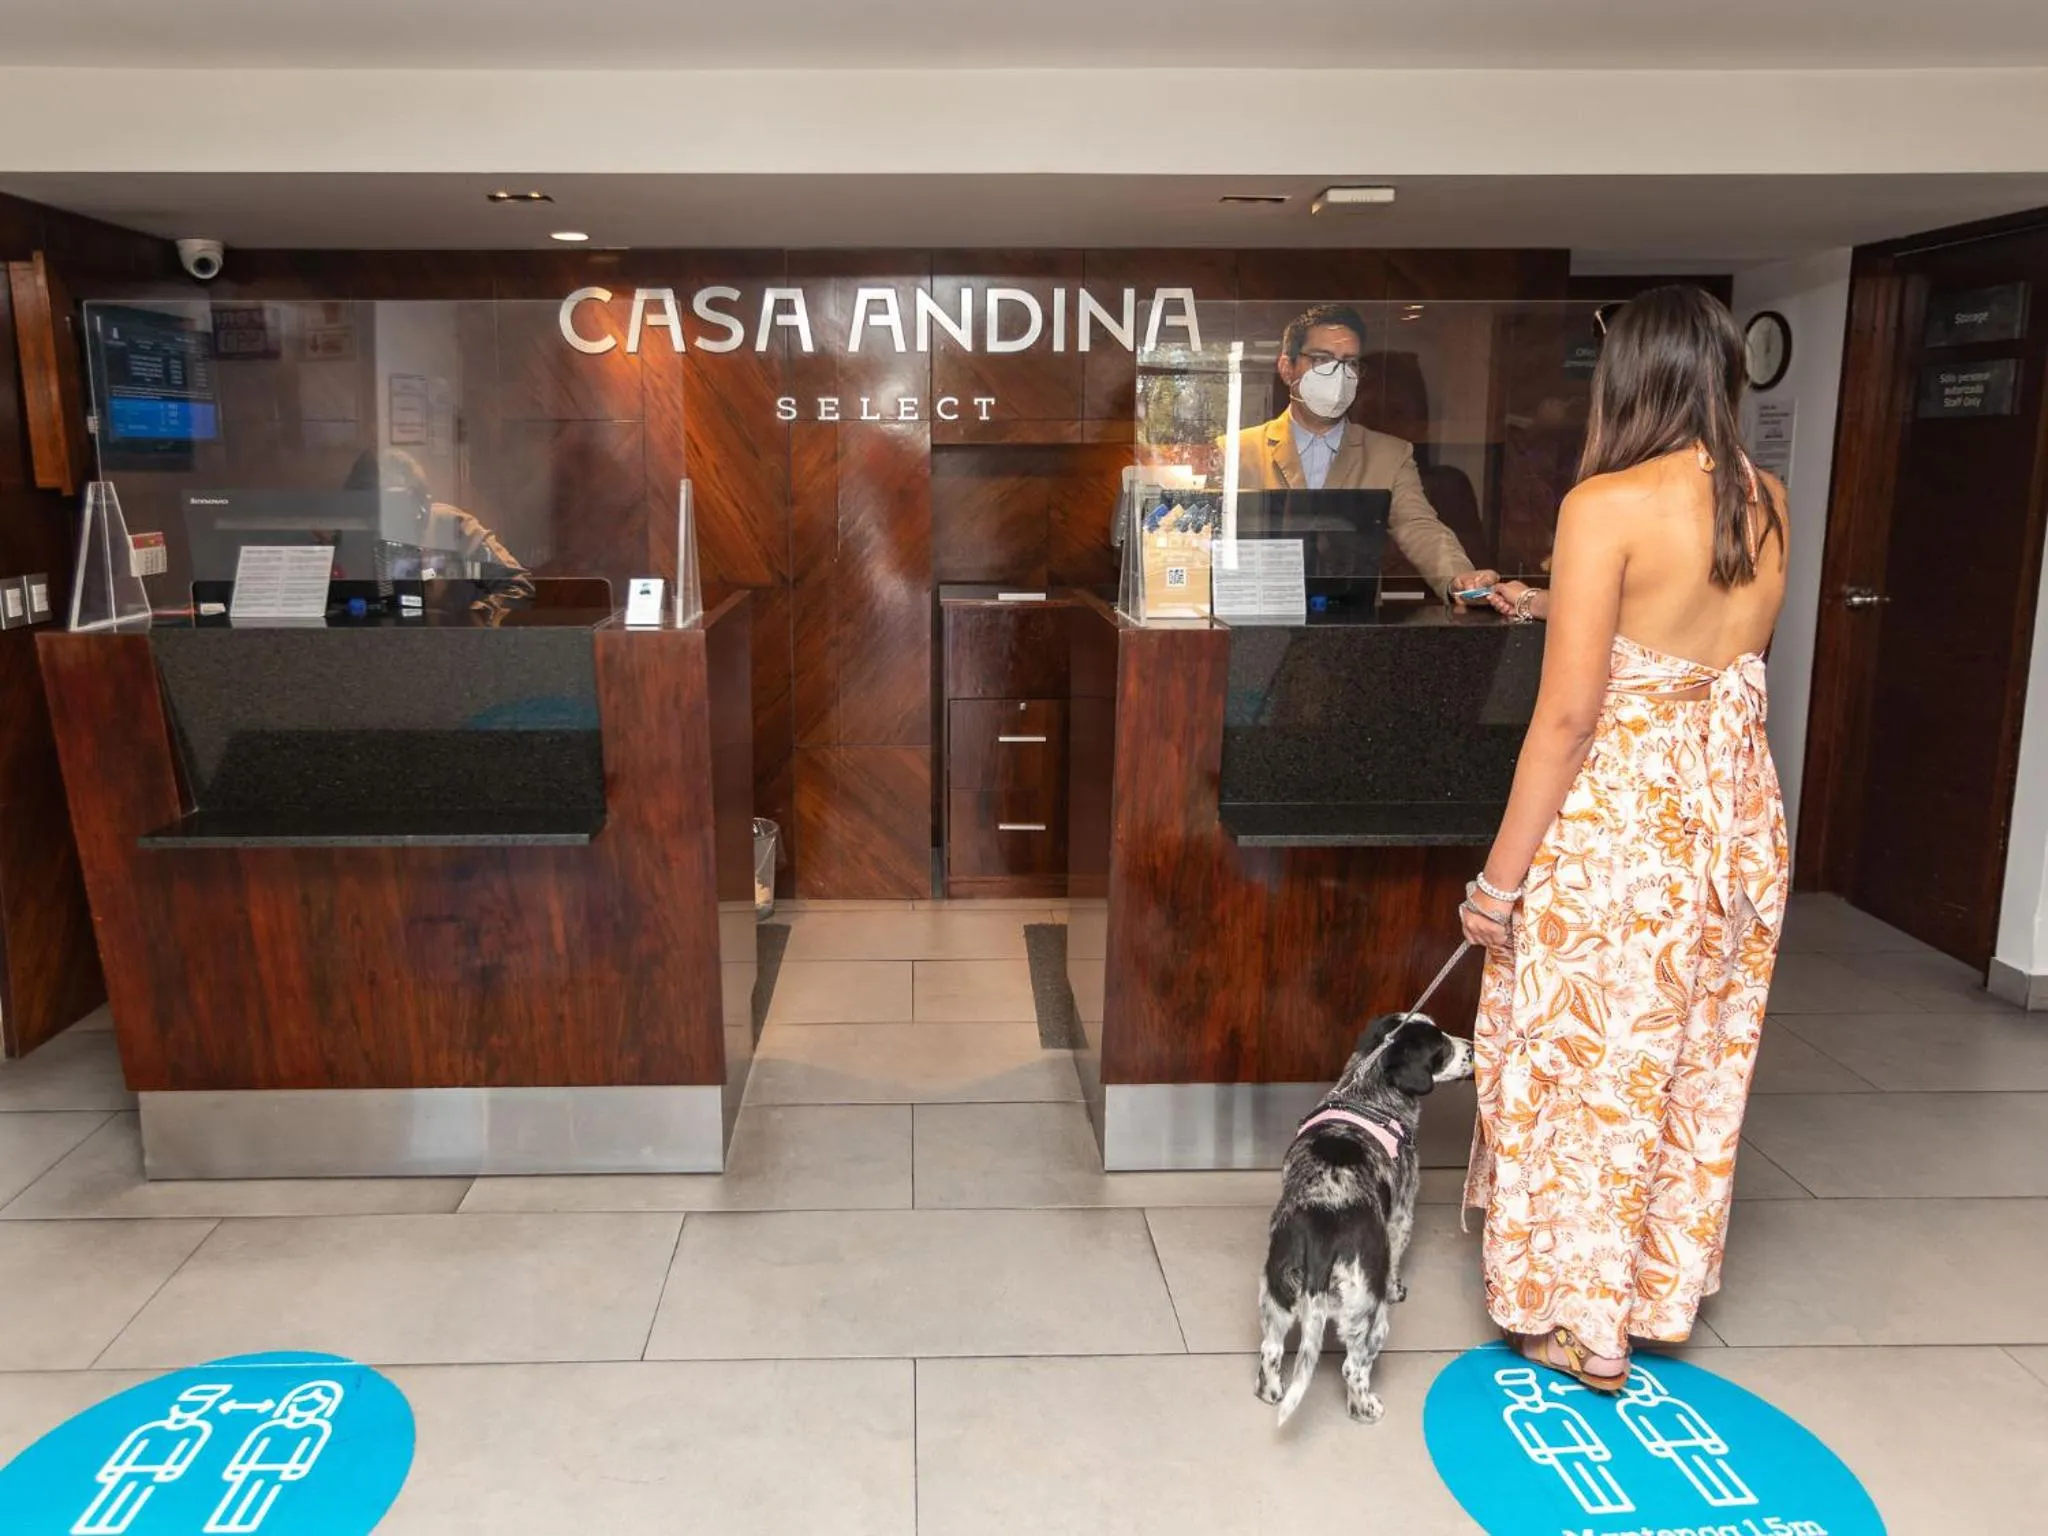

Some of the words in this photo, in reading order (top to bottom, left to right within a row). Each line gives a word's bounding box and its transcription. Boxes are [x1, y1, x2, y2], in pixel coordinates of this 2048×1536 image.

[559, 286, 814, 354] CASA
[848, 286, 1202, 353] ANDINA
[775, 395, 998, 421] SELECT
[1562, 1525, 1742, 1536] tenga
